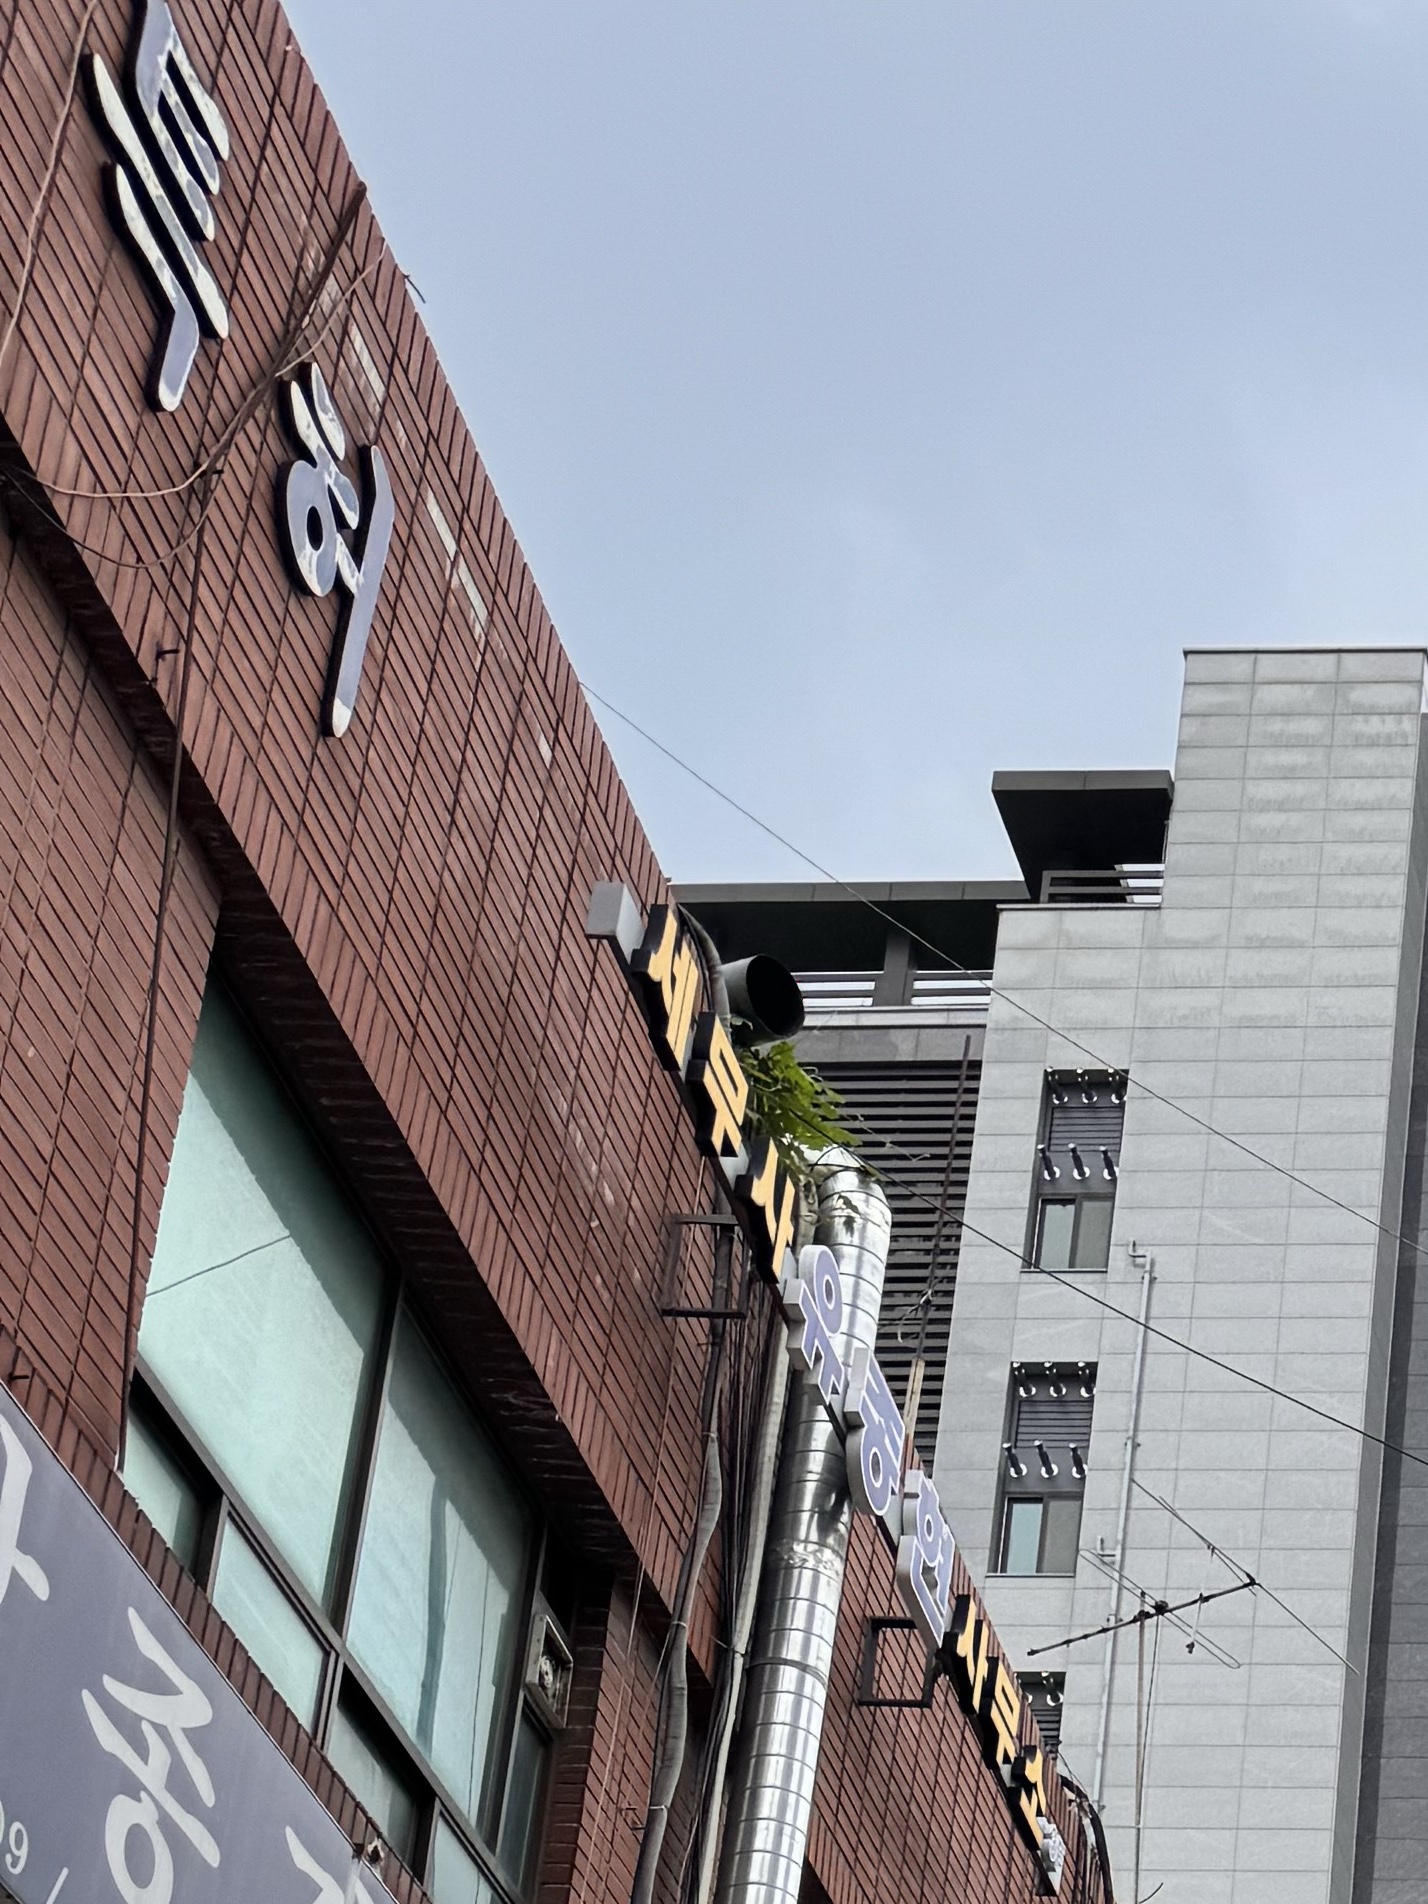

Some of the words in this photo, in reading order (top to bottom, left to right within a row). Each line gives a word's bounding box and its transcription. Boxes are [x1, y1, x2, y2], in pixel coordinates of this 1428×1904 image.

[648, 905, 796, 1285] 세무사
[800, 1245, 957, 1648] 유종현
[956, 1598, 1046, 1851] 사무소
